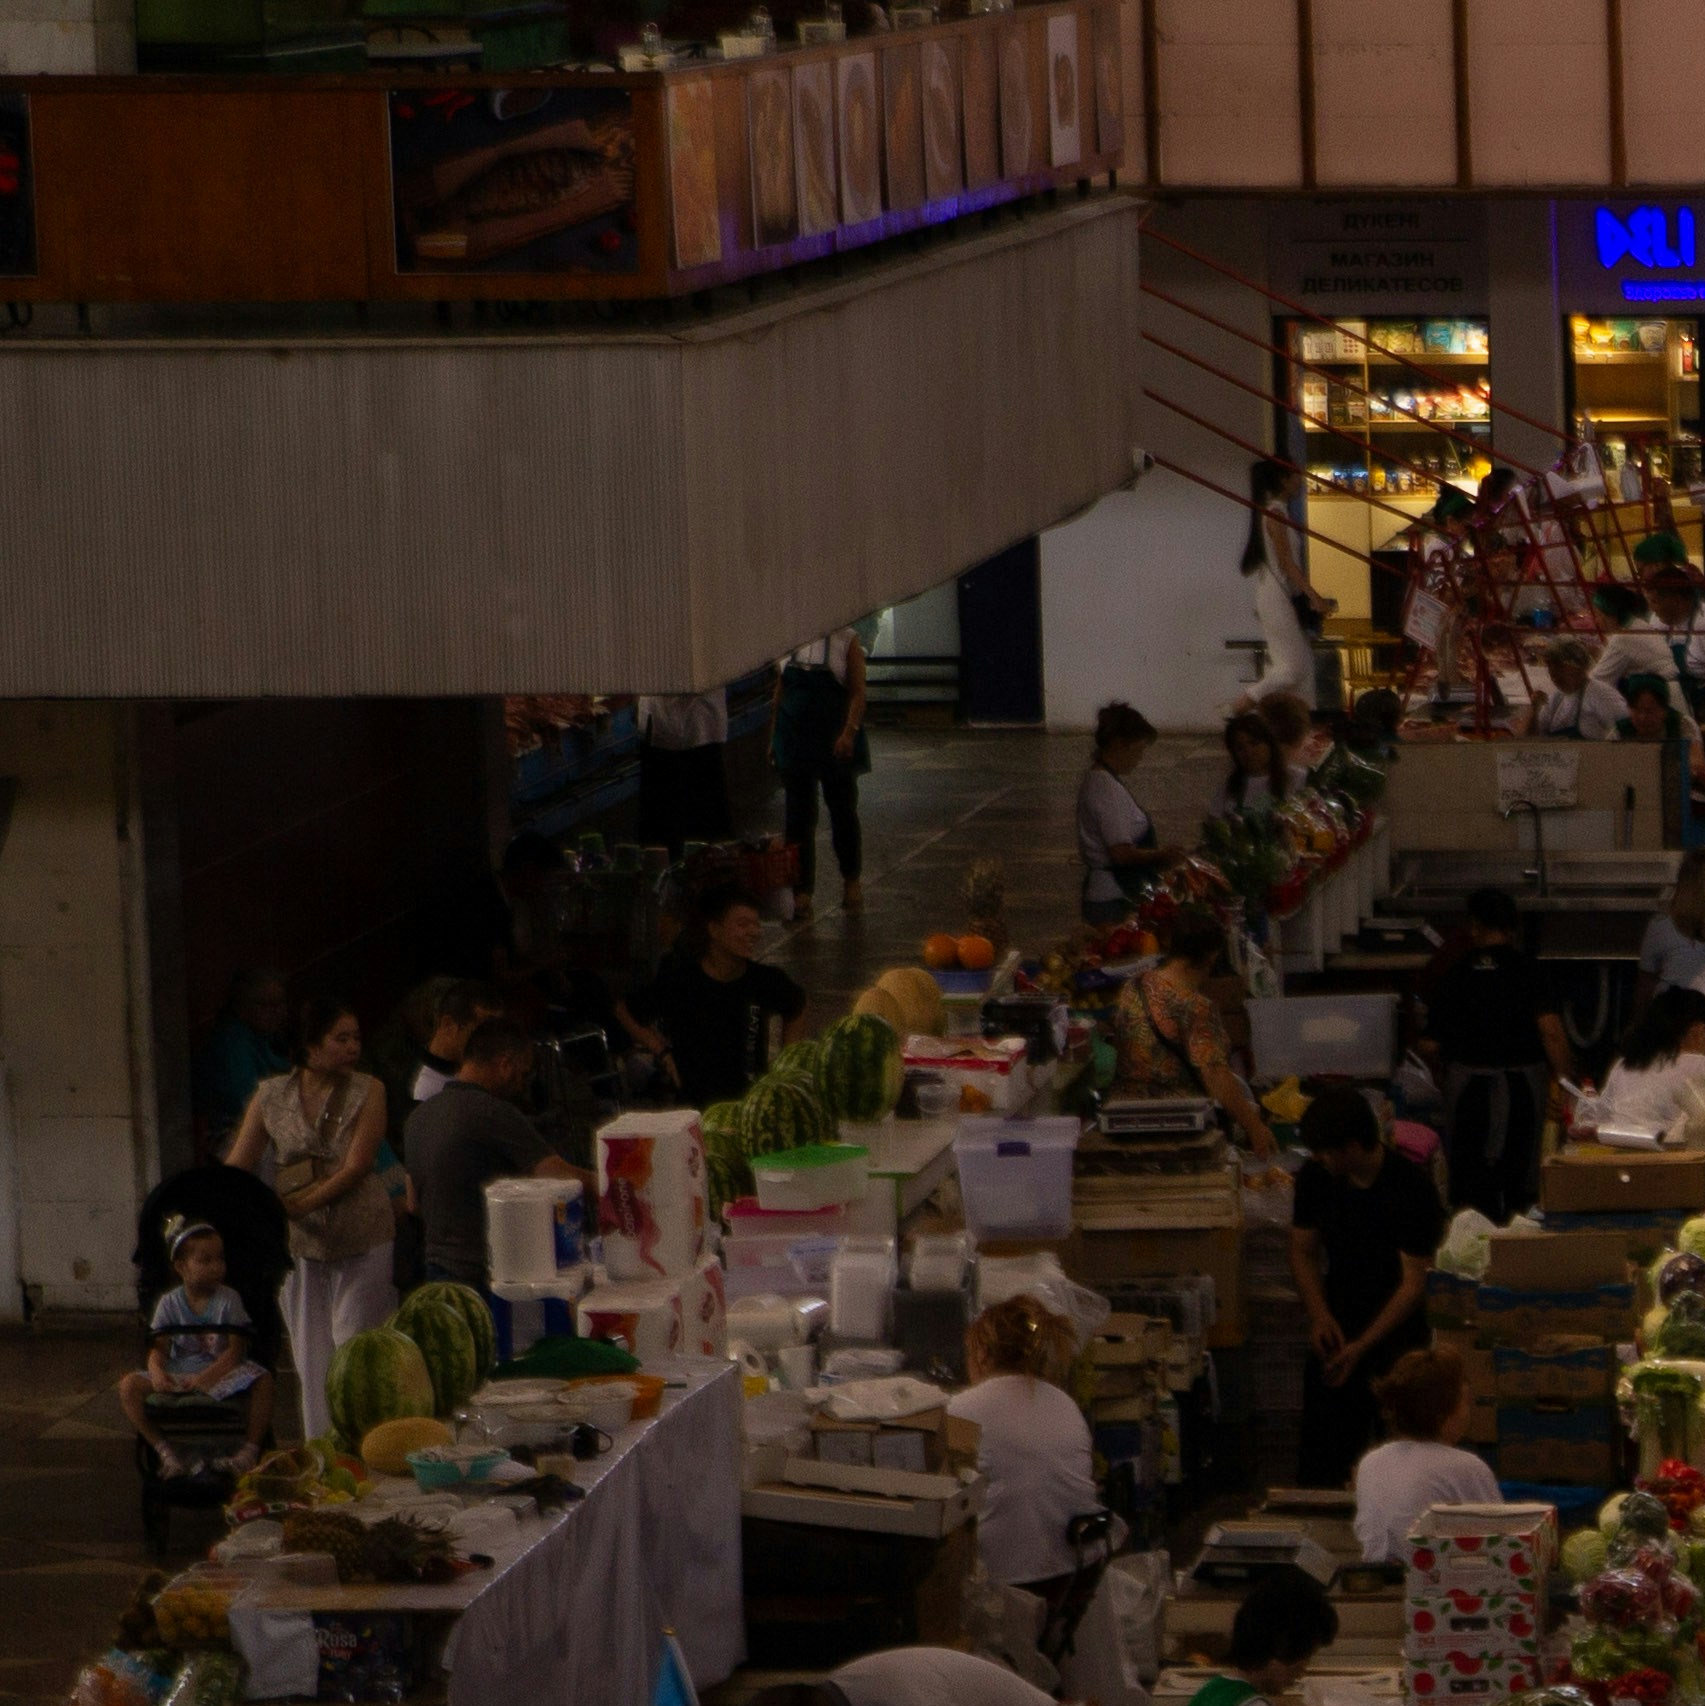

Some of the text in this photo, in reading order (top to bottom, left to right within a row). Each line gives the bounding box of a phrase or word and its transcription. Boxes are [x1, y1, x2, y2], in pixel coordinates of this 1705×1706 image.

[1594, 205, 1696, 269] DELI
[1331, 253, 1434, 268] МАГАЗИН
[1302, 277, 1463, 294] ДЕЛИКАТЕСОВ
